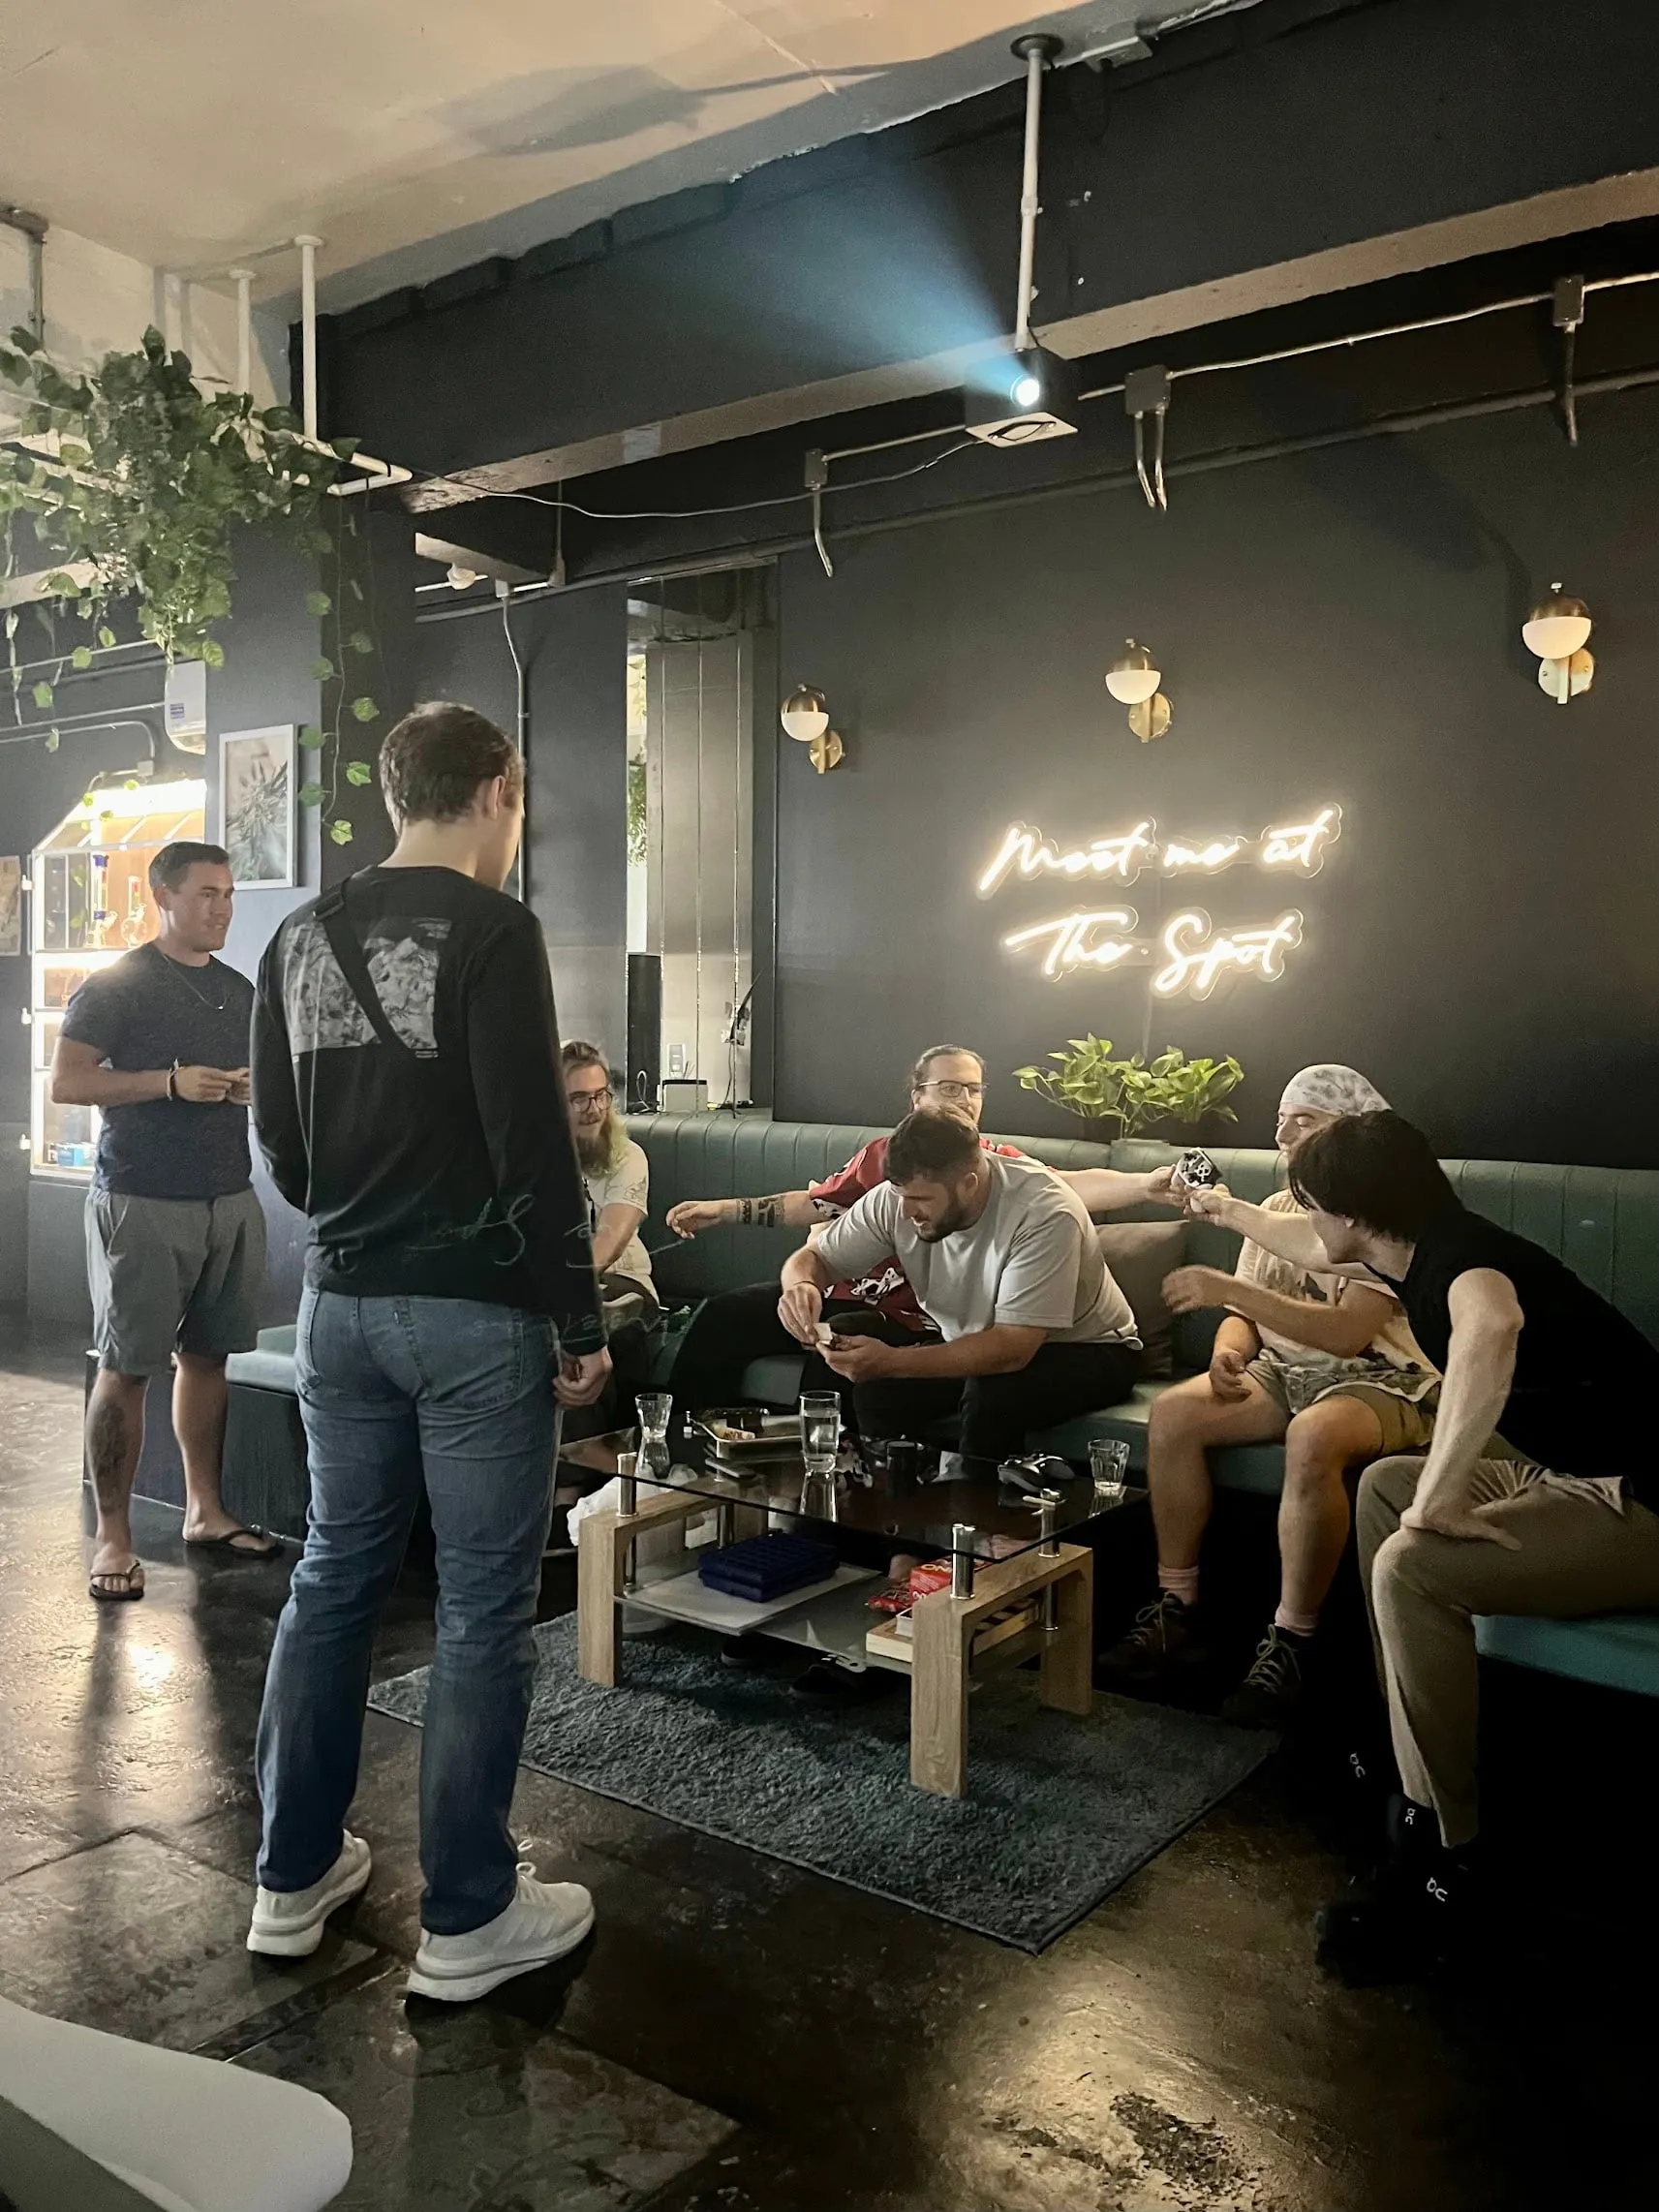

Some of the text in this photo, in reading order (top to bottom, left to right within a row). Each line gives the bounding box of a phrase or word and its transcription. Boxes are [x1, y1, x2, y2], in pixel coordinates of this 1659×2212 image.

[979, 809, 1335, 891] Meet me at
[1005, 910, 1297, 992] The Spot
